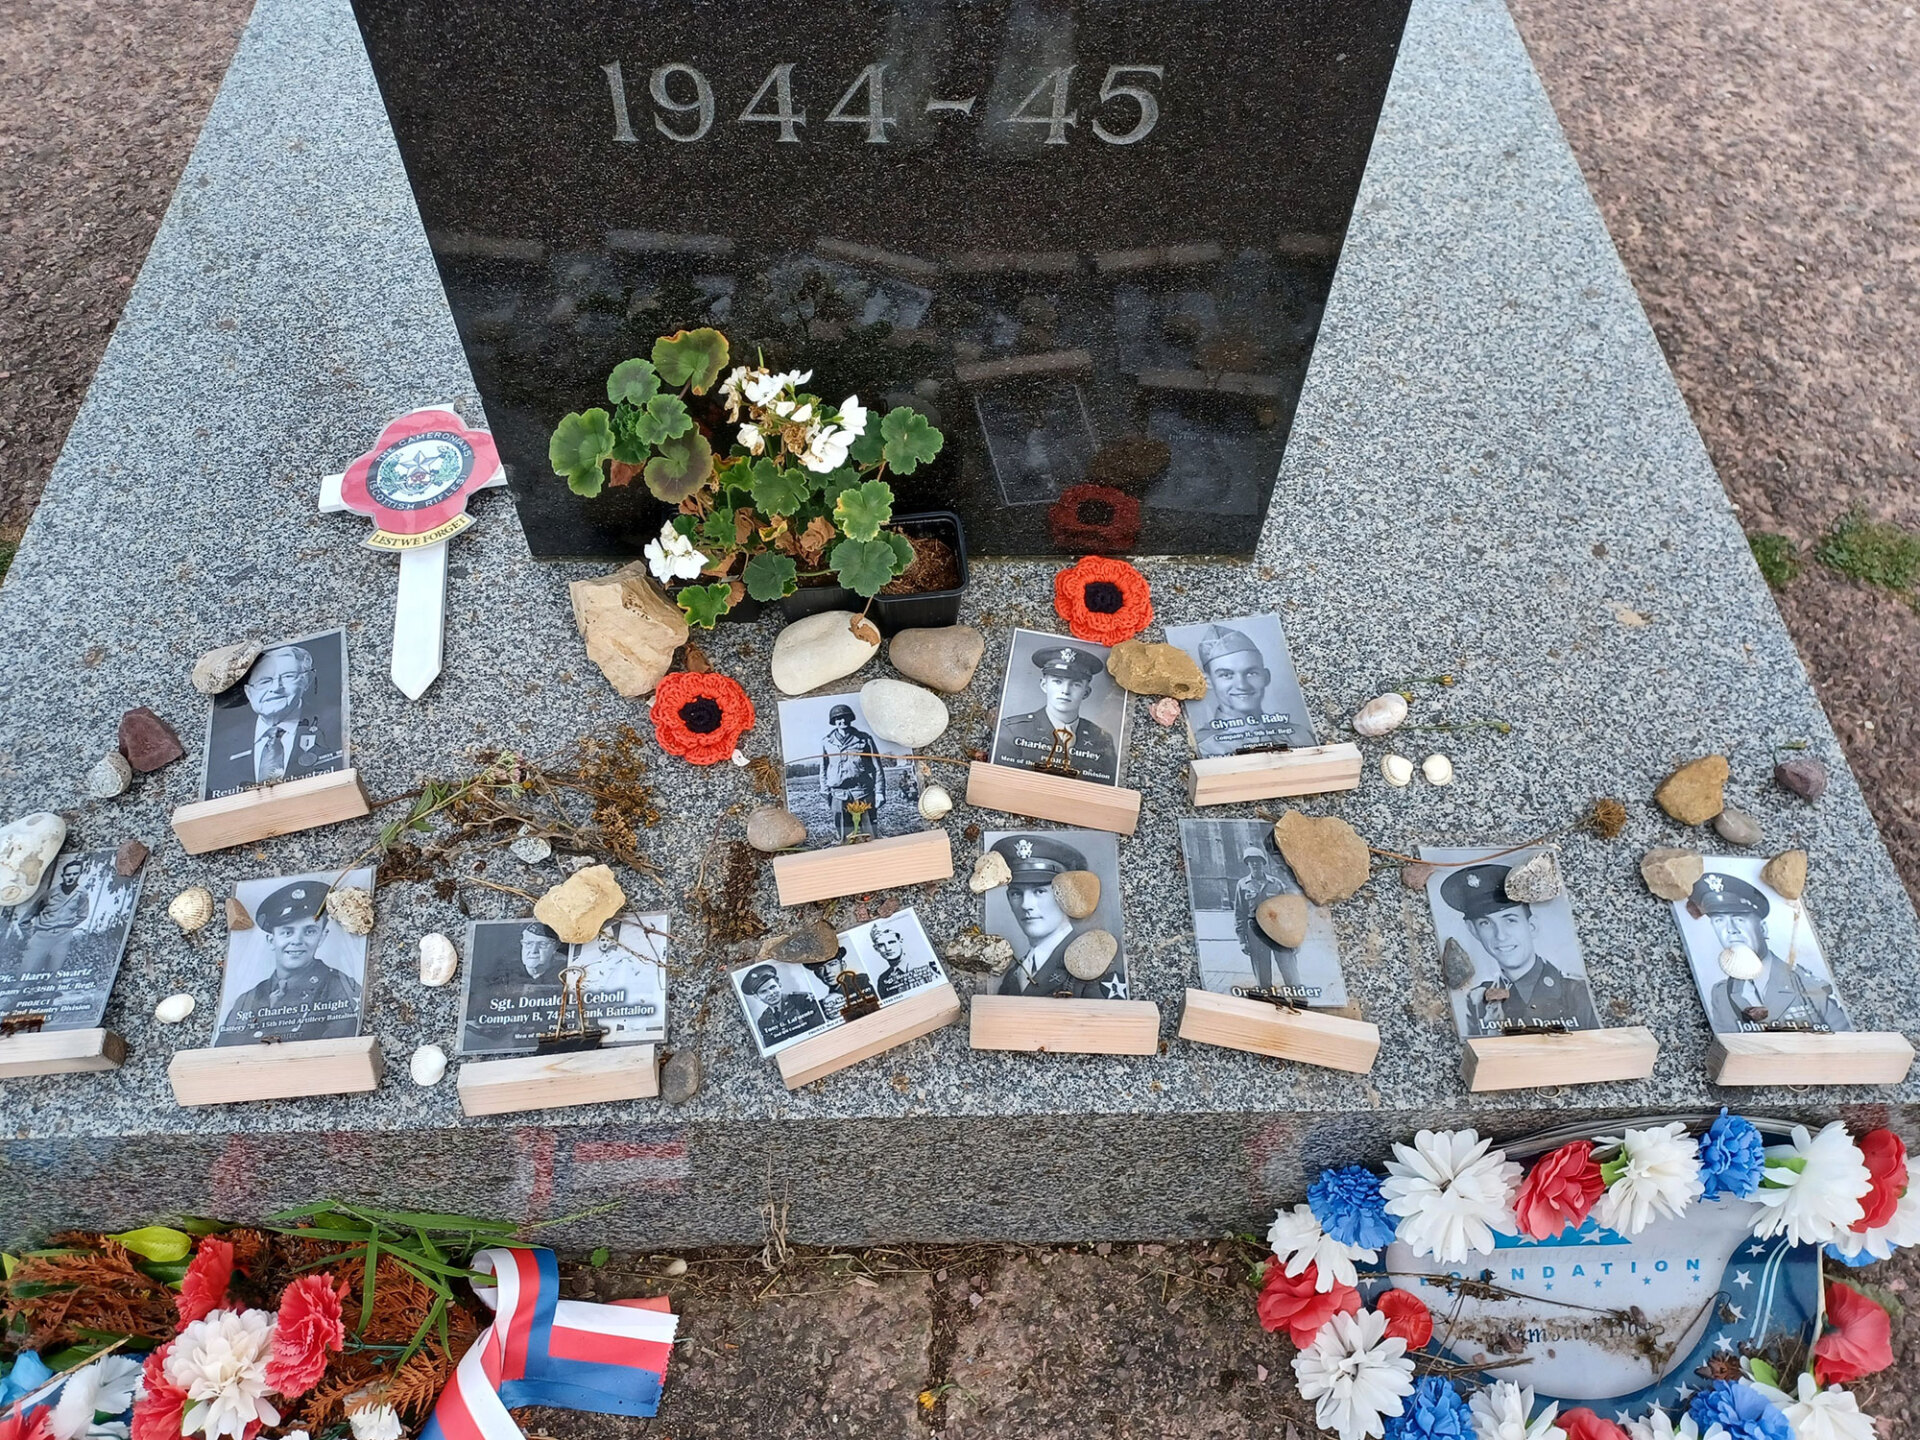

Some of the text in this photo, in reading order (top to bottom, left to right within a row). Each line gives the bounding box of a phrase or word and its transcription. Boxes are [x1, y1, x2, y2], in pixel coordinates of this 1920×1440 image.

[376, 431, 472, 463] THE CAMERONIANS
[369, 475, 467, 510] (SCOTTISH RIFLES)
[423, 516, 467, 543] FORGET
[1211, 713, 1290, 730] Glynn G. Raby
[1014, 737, 1052, 751] Charles
[1069, 747, 1100, 761] Curley
[1082, 769, 1111, 780] Division
[20, 972, 52, 981] Harry
[490, 998, 515, 1011] Sgt.
[519, 994, 564, 1008] Donald
[583, 990, 625, 1004] Ceboll
[1283, 985, 1322, 997] Rider
[60, 1004, 91, 1012] Division
[236, 1000, 349, 1021] Sgt. Charles D. Knight
[478, 1013, 530, 1026] Company
[532, 1012, 543, 1022] B,
[546, 1009, 576, 1021] 74st
[606, 1004, 655, 1018] Battalion
[261, 1020, 278, 1029] 15th
[278, 1018, 296, 1027] Field
[326, 1011, 358, 1021] Battalion
[1479, 1018, 1512, 1031] Loyd
[1532, 1016, 1580, 1028] Daniel
[1420, 1258, 1700, 1287] ONDATION
